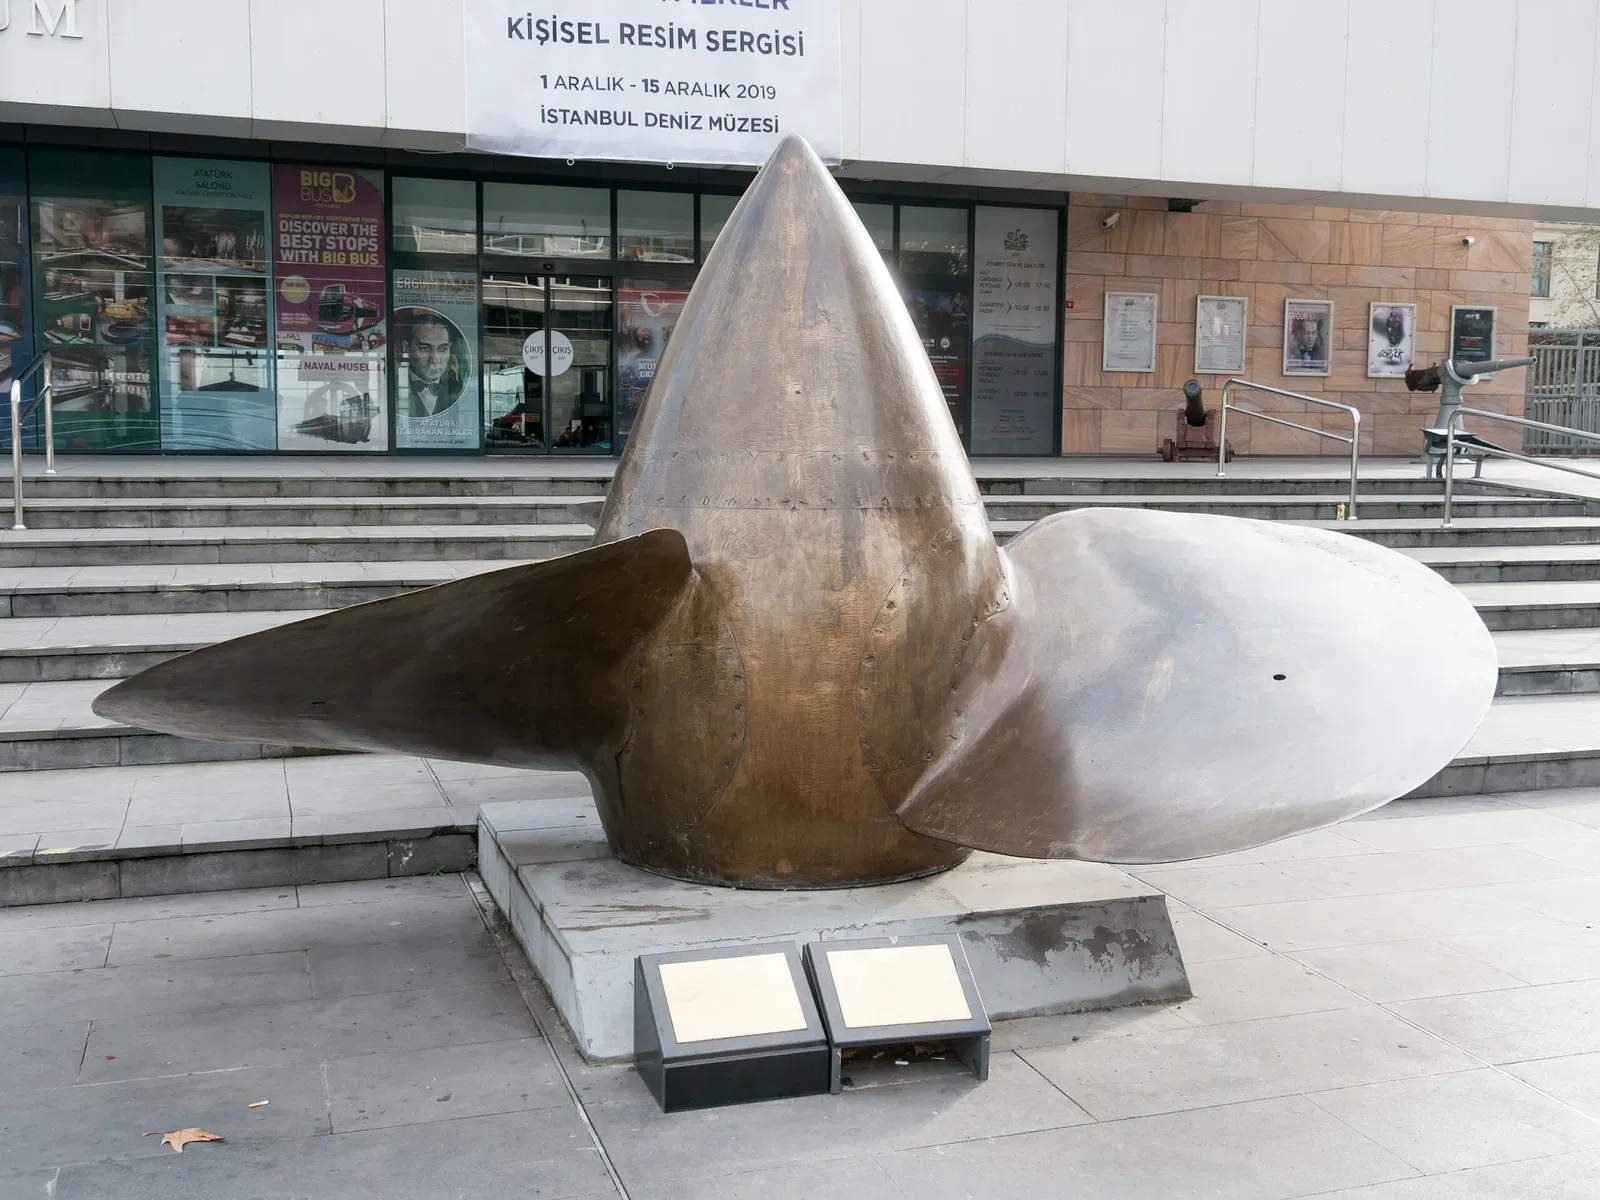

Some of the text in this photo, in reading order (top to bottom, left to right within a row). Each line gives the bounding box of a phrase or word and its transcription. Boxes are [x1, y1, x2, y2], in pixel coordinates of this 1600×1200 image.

[507, 12, 804, 57] KİŞİSEL RESİM SERGİSİ
[540, 75, 548, 89] 1
[554, 75, 625, 92] ARALIK
[641, 78, 660, 93] 15
[664, 81, 731, 98] ARALIK
[736, 84, 776, 100] 2019
[540, 105, 779, 134] İSTANBUL DENİZ MÜZESİ
[193, 168, 233, 179] ATATÜRK
[300, 170, 331, 188] BIG
[195, 180, 232, 190] SALONU
[300, 186, 332, 202] BUS
[279, 220, 379, 236] DISCOVER THE
[280, 233, 379, 252] BEST STOPS
[280, 248, 379, 266] WITH BIG BUS
[524, 345, 545, 356] ÇIKIŞ
[552, 346, 572, 356] ÇIKIŞ
[304, 361, 336, 371] NAVAL
